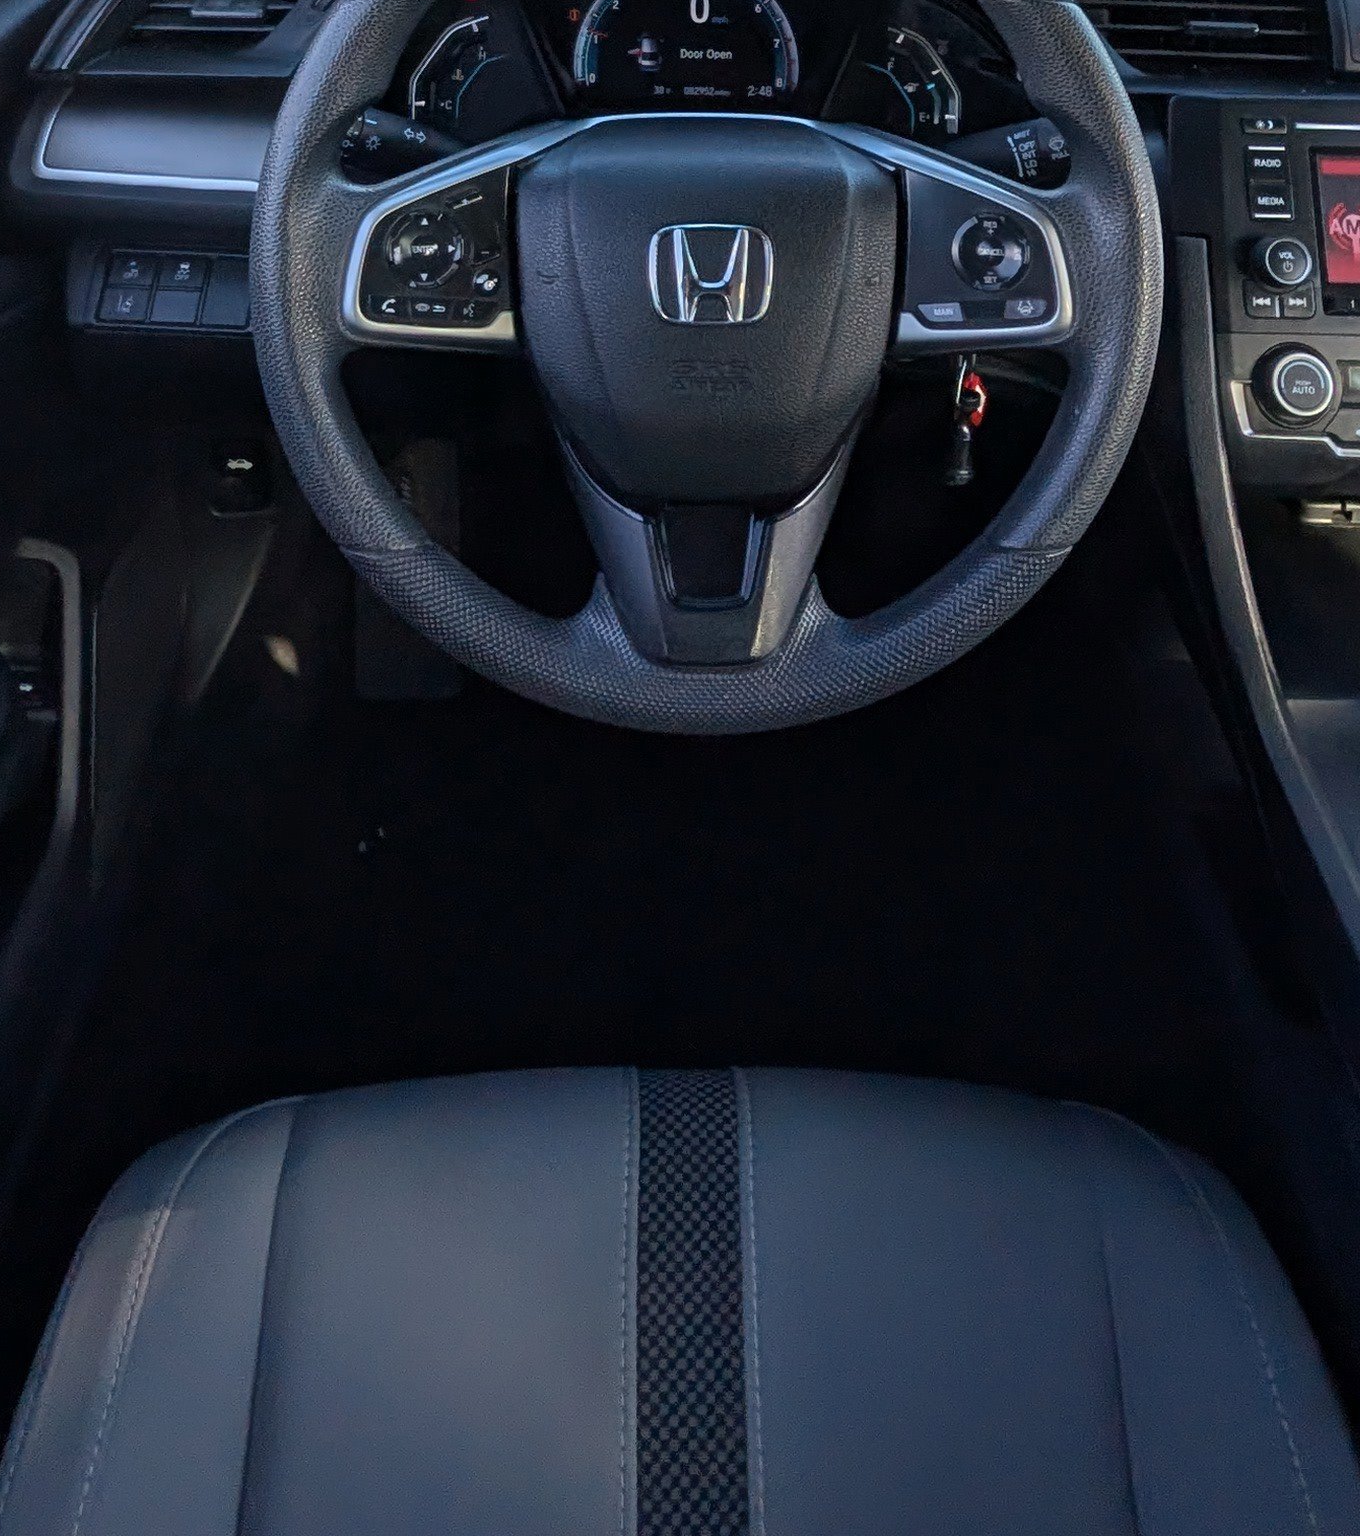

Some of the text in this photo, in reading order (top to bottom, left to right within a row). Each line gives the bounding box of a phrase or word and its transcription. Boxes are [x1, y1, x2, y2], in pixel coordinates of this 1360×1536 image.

[612, 0, 619, 10] 2
[755, 4, 762, 13] 6
[773, 39, 780, 48] 7
[680, 49, 733, 61] Door Open
[747, 85, 773, 97] 2:48
[1254, 158, 1281, 168] RADIO
[1257, 196, 1285, 206] MEDIA
[1278, 252, 1295, 261] VOL
[1292, 386, 1316, 395] AUTO
